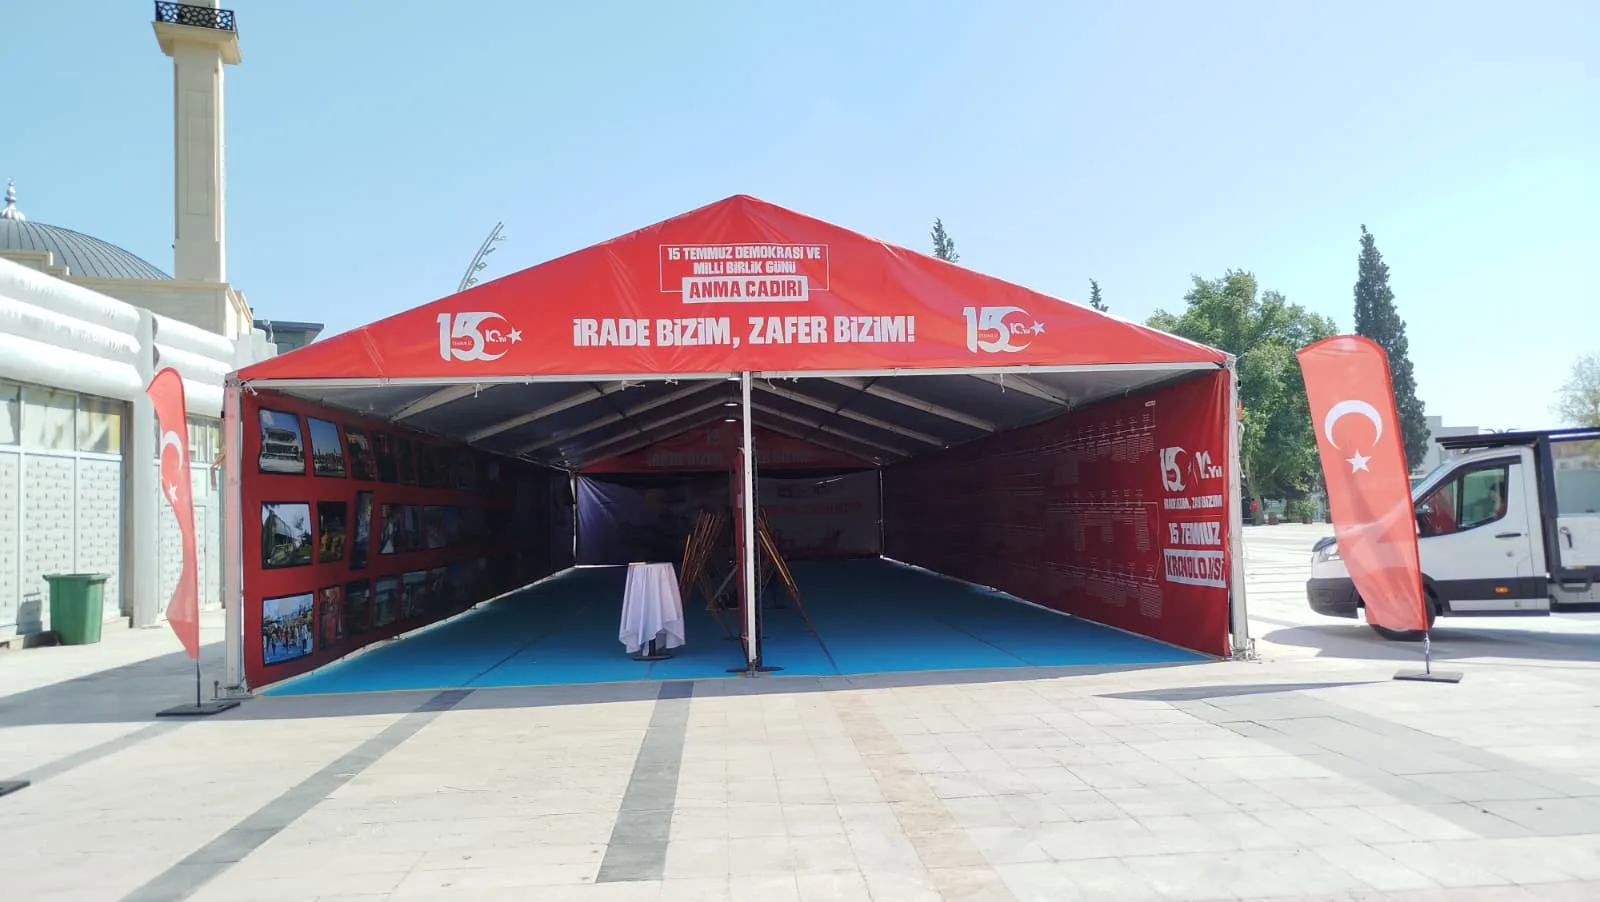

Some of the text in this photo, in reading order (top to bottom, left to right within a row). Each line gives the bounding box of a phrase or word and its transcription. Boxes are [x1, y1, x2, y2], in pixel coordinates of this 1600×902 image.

[667, 247, 680, 260] 15
[682, 246, 733, 260] TEMMUZ
[806, 246, 821, 259] VE
[689, 280, 742, 298] ANMA
[437, 311, 487, 361] 15
[748, 316, 828, 345] ZAFER
[962, 306, 1011, 352] 15
